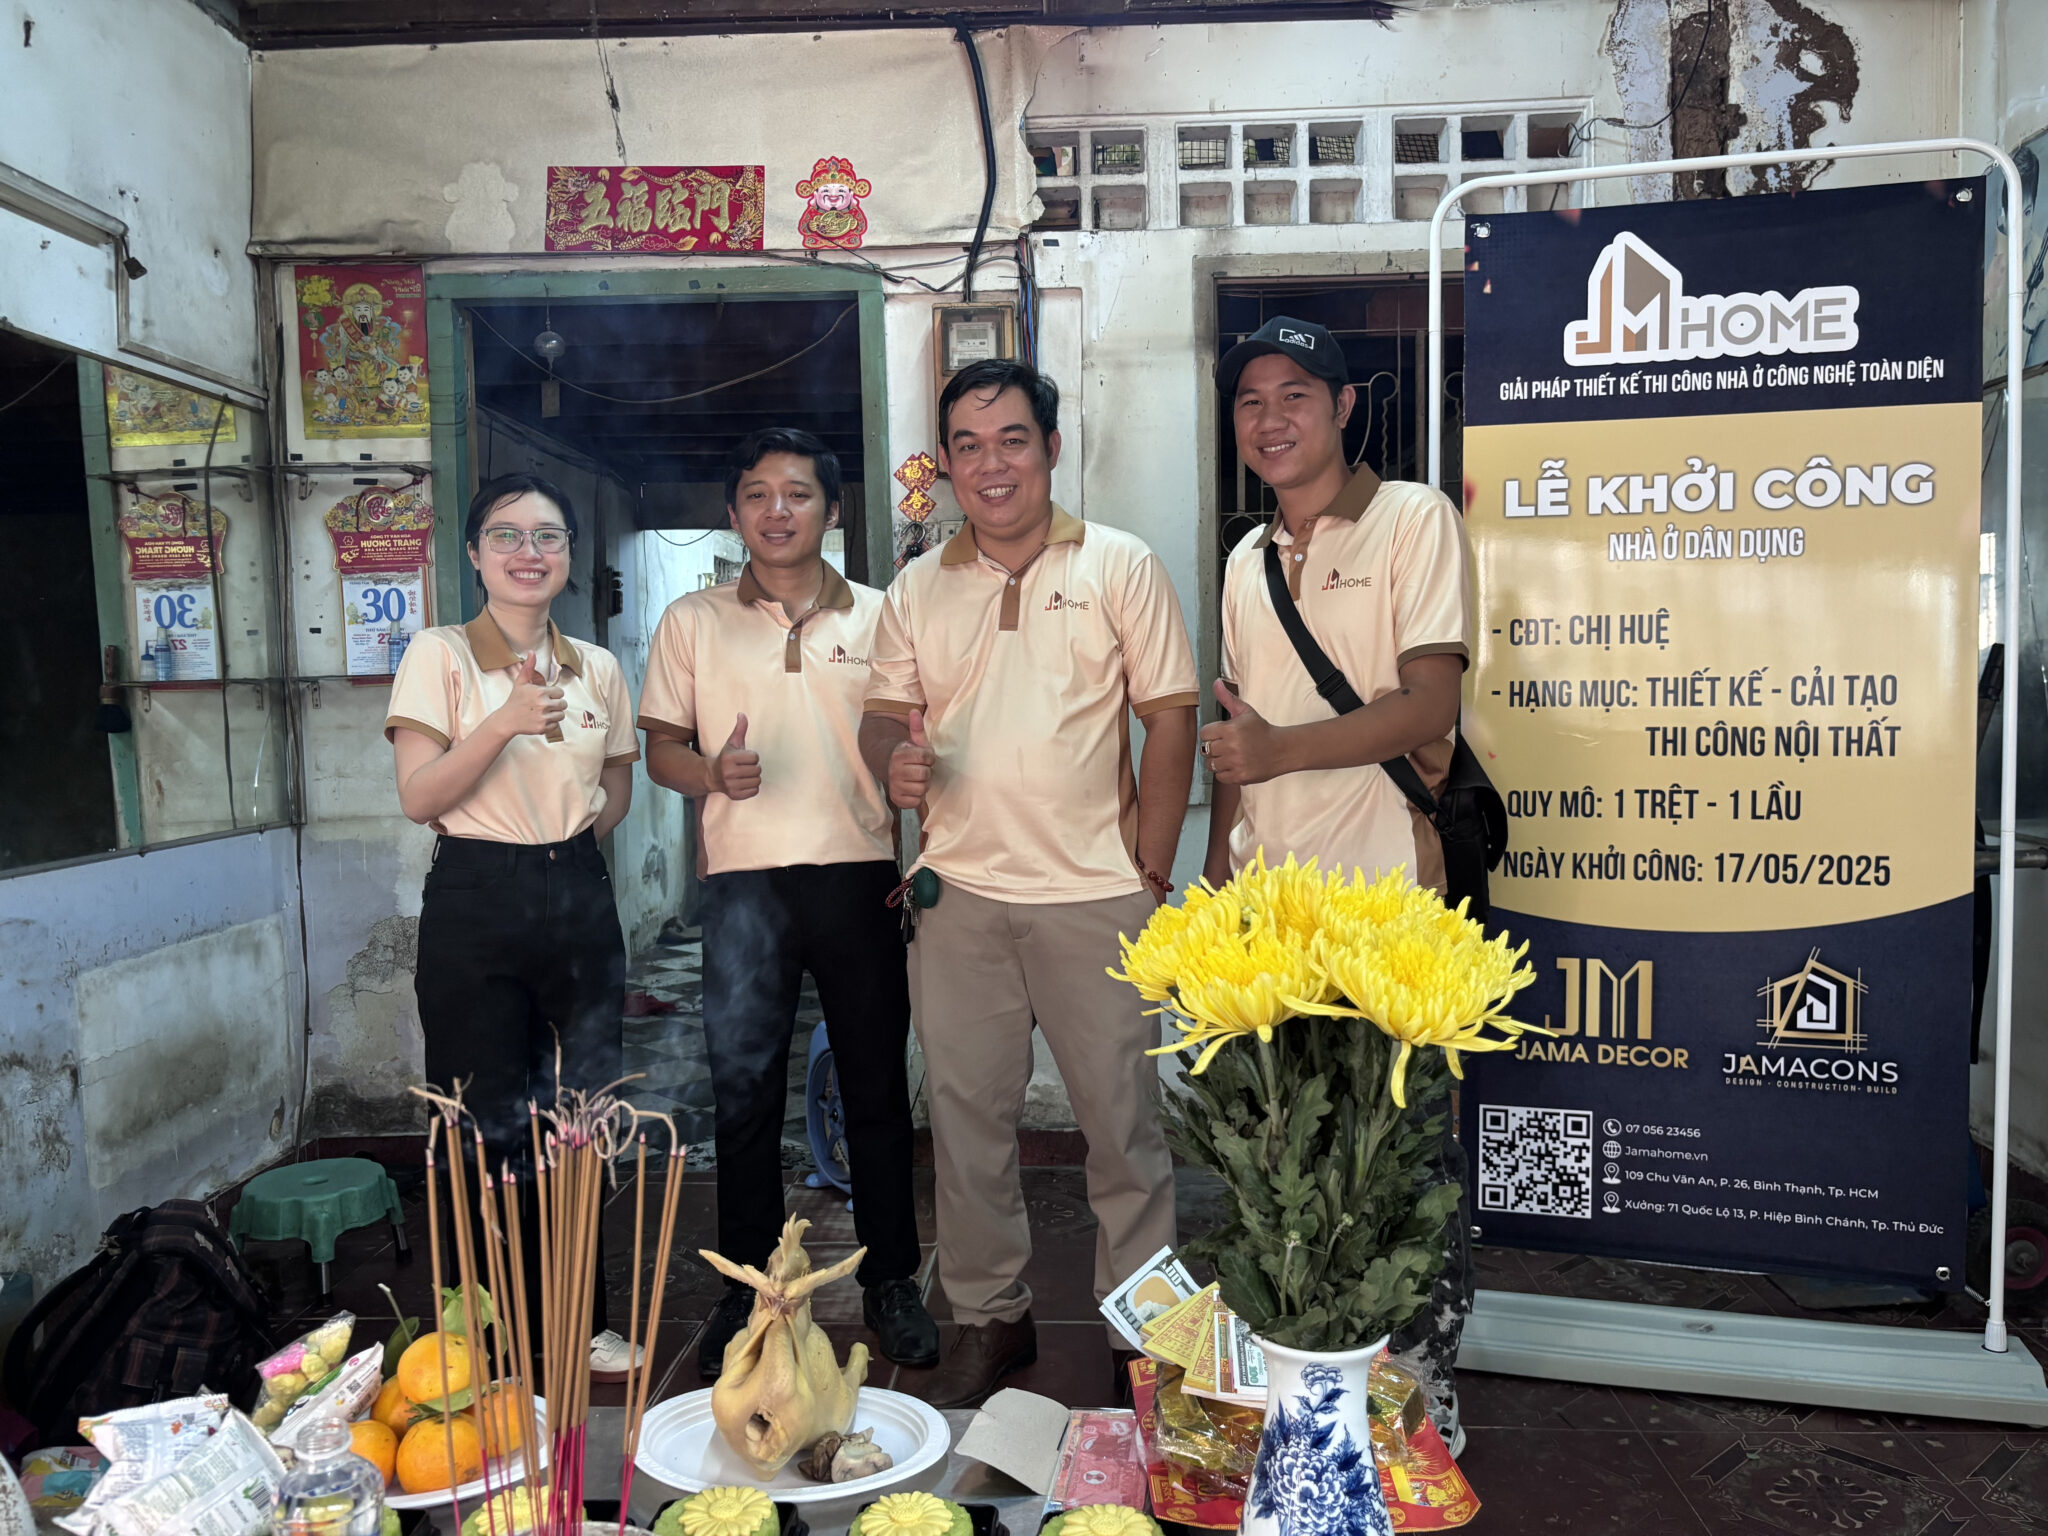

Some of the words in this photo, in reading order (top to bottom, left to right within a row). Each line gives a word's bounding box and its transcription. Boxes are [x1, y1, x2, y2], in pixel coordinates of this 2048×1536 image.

[577, 181, 731, 233] 五福臨門
[1284, 338, 1309, 349] adidas
[1500, 377, 1528, 400] GIẢI
[1532, 377, 1571, 399] PHÁP
[1574, 372, 1616, 397] THIẾT
[1620, 370, 1643, 395] KẾ
[1643, 373, 1667, 394] THI
[1671, 369, 1712, 392] CÔNG
[1716, 367, 1749, 389] NHÀ
[1752, 363, 1764, 388] Ở
[1767, 364, 1809, 387] CÔNG
[1813, 360, 1856, 386] NGHỆ
[1860, 358, 1902, 382] TOÀN
[1906, 356, 1944, 382] DIỆN
[1504, 458, 1570, 518] LỄ
[1587, 456, 1735, 515] KHỞI
[1753, 455, 1935, 510] CÔNG
[393, 538, 421, 547] TRANG
[1608, 527, 1657, 561] NHÀ
[1663, 523, 1679, 560] Ở
[1684, 525, 1733, 559] DÂN
[1739, 527, 1804, 563] DỤNG
[361, 587, 406, 623] 30
[1509, 618, 1561, 646] CĐT:
[1569, 614, 1610, 651] CHỊ
[1619, 607, 1670, 650] HUỆ
[1509, 680, 1572, 713] HẠNG
[1579, 680, 1638, 713] MỤC:
[1646, 667, 1721, 707] THIẾT
[1729, 666, 1769, 707] KẾ
[1790, 665, 1835, 706] CẢI
[1843, 674, 1897, 712] TẠO
[1645, 726, 1687, 756] THI
[1695, 720, 1766, 757] CÔNG
[1774, 719, 1819, 763] NỘI
[1827, 716, 1901, 757] THẤT
[1507, 790, 1553, 818] QUY
[1560, 785, 1602, 818] MÔ:
[1614, 789, 1624, 818] 1
[1634, 783, 1699, 825] TRỆT
[1729, 789, 1739, 820] 1
[1750, 780, 1802, 821] LẦU
[1503, 846, 1565, 879] NGÀY
[1572, 844, 1625, 880] KHỞI
[1633, 848, 1703, 882] CÔNG:
[1714, 852, 1891, 886] 17/05/2025
[1545, 957, 1653, 1040] JM
[1514, 1040, 1590, 1064] JAMA
[1597, 1043, 1689, 1069] DECOR
[1722, 1053, 1899, 1083] JAMACONS
[1725, 1077, 1762, 1086] DESIGN
[1866, 1086, 1898, 1095] BUILD
[1625, 1124, 1640, 1133] 07
[1642, 1125, 1664, 1135] 056
[1666, 1126, 1701, 1138] 23456
[1624, 1145, 1708, 1161] Jamahome.vn
[1625, 1170, 1643, 1181] 109
[1646, 1171, 1669, 1183] Chu
[1672, 1174, 1695, 1184] Văn
[1698, 1175, 1717, 1188] An,
[1720, 1177, 1731, 1188] P.
[1733, 1178, 1750, 1190] 26,
[1753, 1180, 1781, 1191] Bình
[1784, 1182, 1825, 1196] Thạnh,
[1828, 1186, 1846, 1198] Tp.
[1849, 1187, 1879, 1199] HCM
[1625, 1199, 1665, 1213] Xưởng:
[1667, 1202, 1679, 1213] 71
[1681, 1203, 1713, 1216] Quốc
[1716, 1207, 1730, 1219] Lộ
[1732, 1208, 1746, 1220] 13,
[1749, 1209, 1760, 1220] P.
[1763, 1211, 1791, 1224] Hiệp
[1794, 1213, 1822, 1225] Bình
[1825, 1216, 1868, 1230] Chánh,
[1871, 1219, 1889, 1232] Tp.
[1892, 1221, 1916, 1233] Thủ
[1919, 1223, 1944, 1234] Đức
